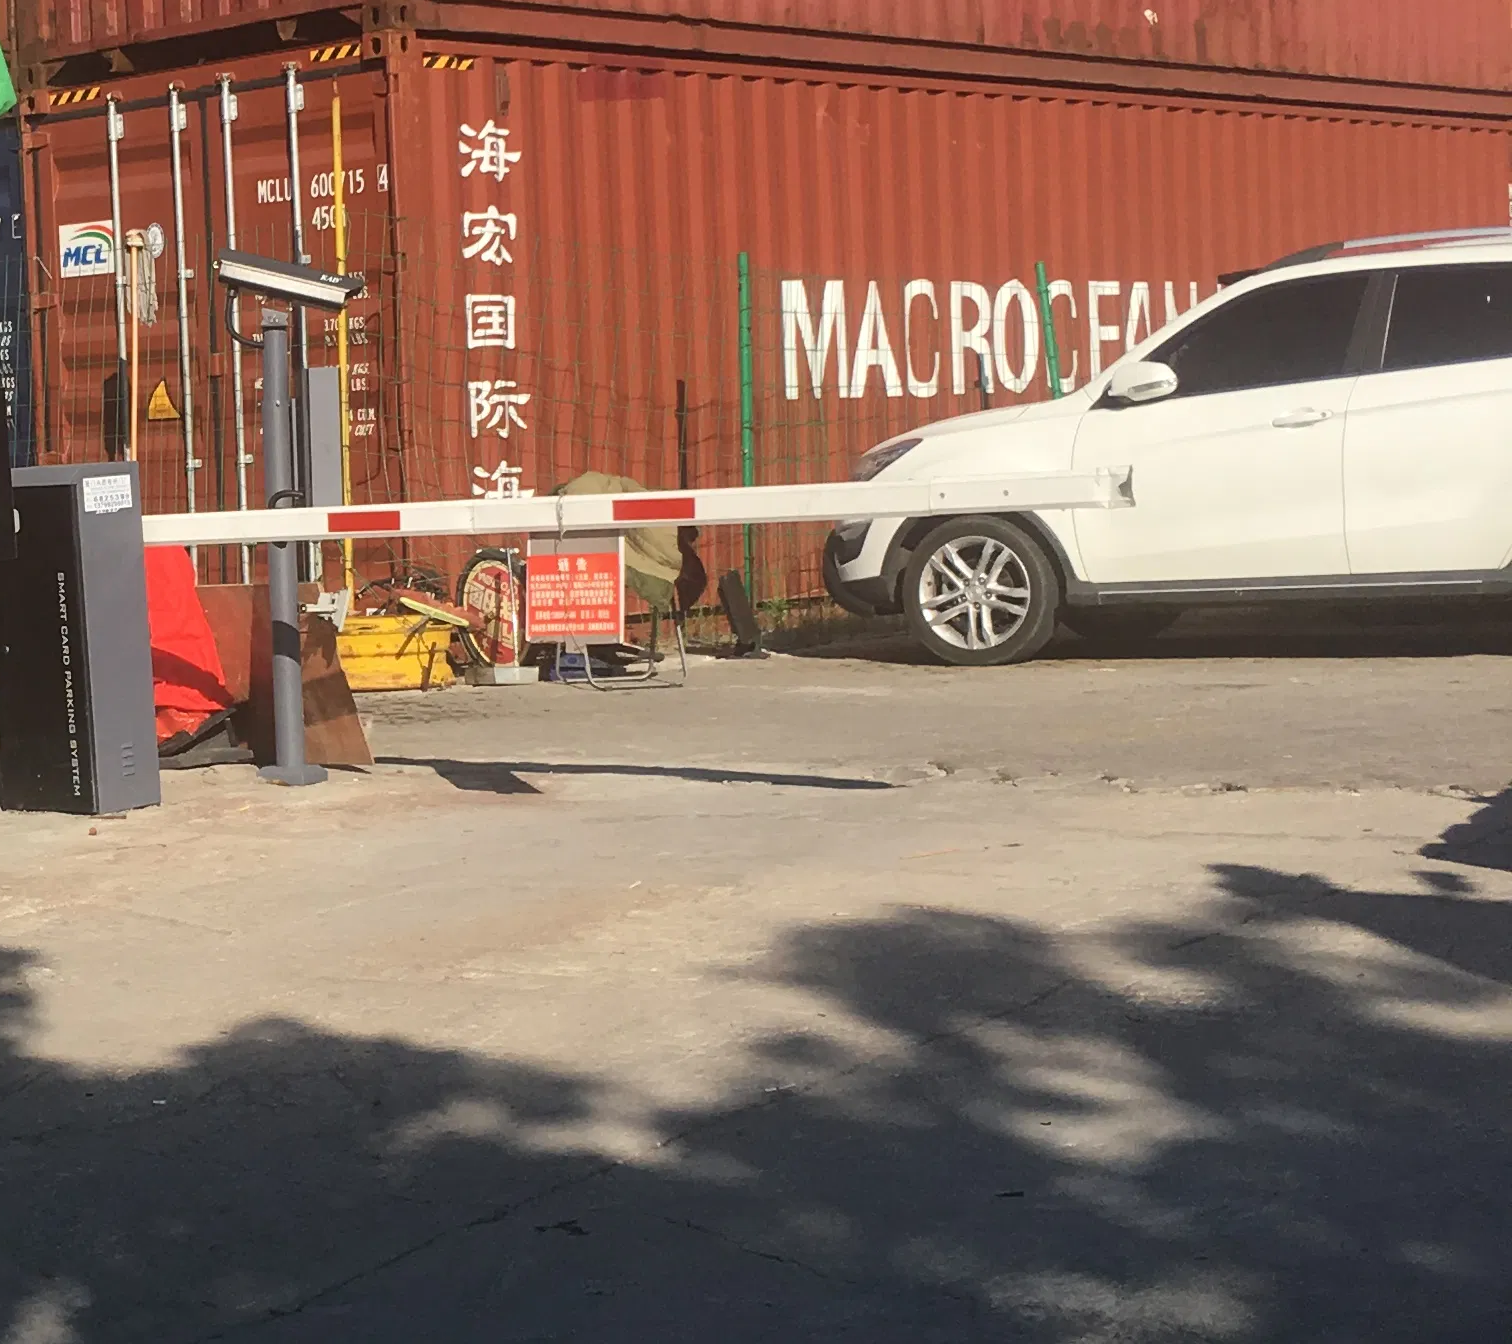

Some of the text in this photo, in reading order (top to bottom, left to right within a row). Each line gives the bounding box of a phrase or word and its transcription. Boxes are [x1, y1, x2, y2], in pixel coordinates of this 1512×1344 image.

[377, 164, 389, 192] 4
[62, 244, 108, 268] MCL
[458, 119, 535, 502] 海宏国际海
[57, 572, 81, 796] SMART CARD PARKING SYSTEM
